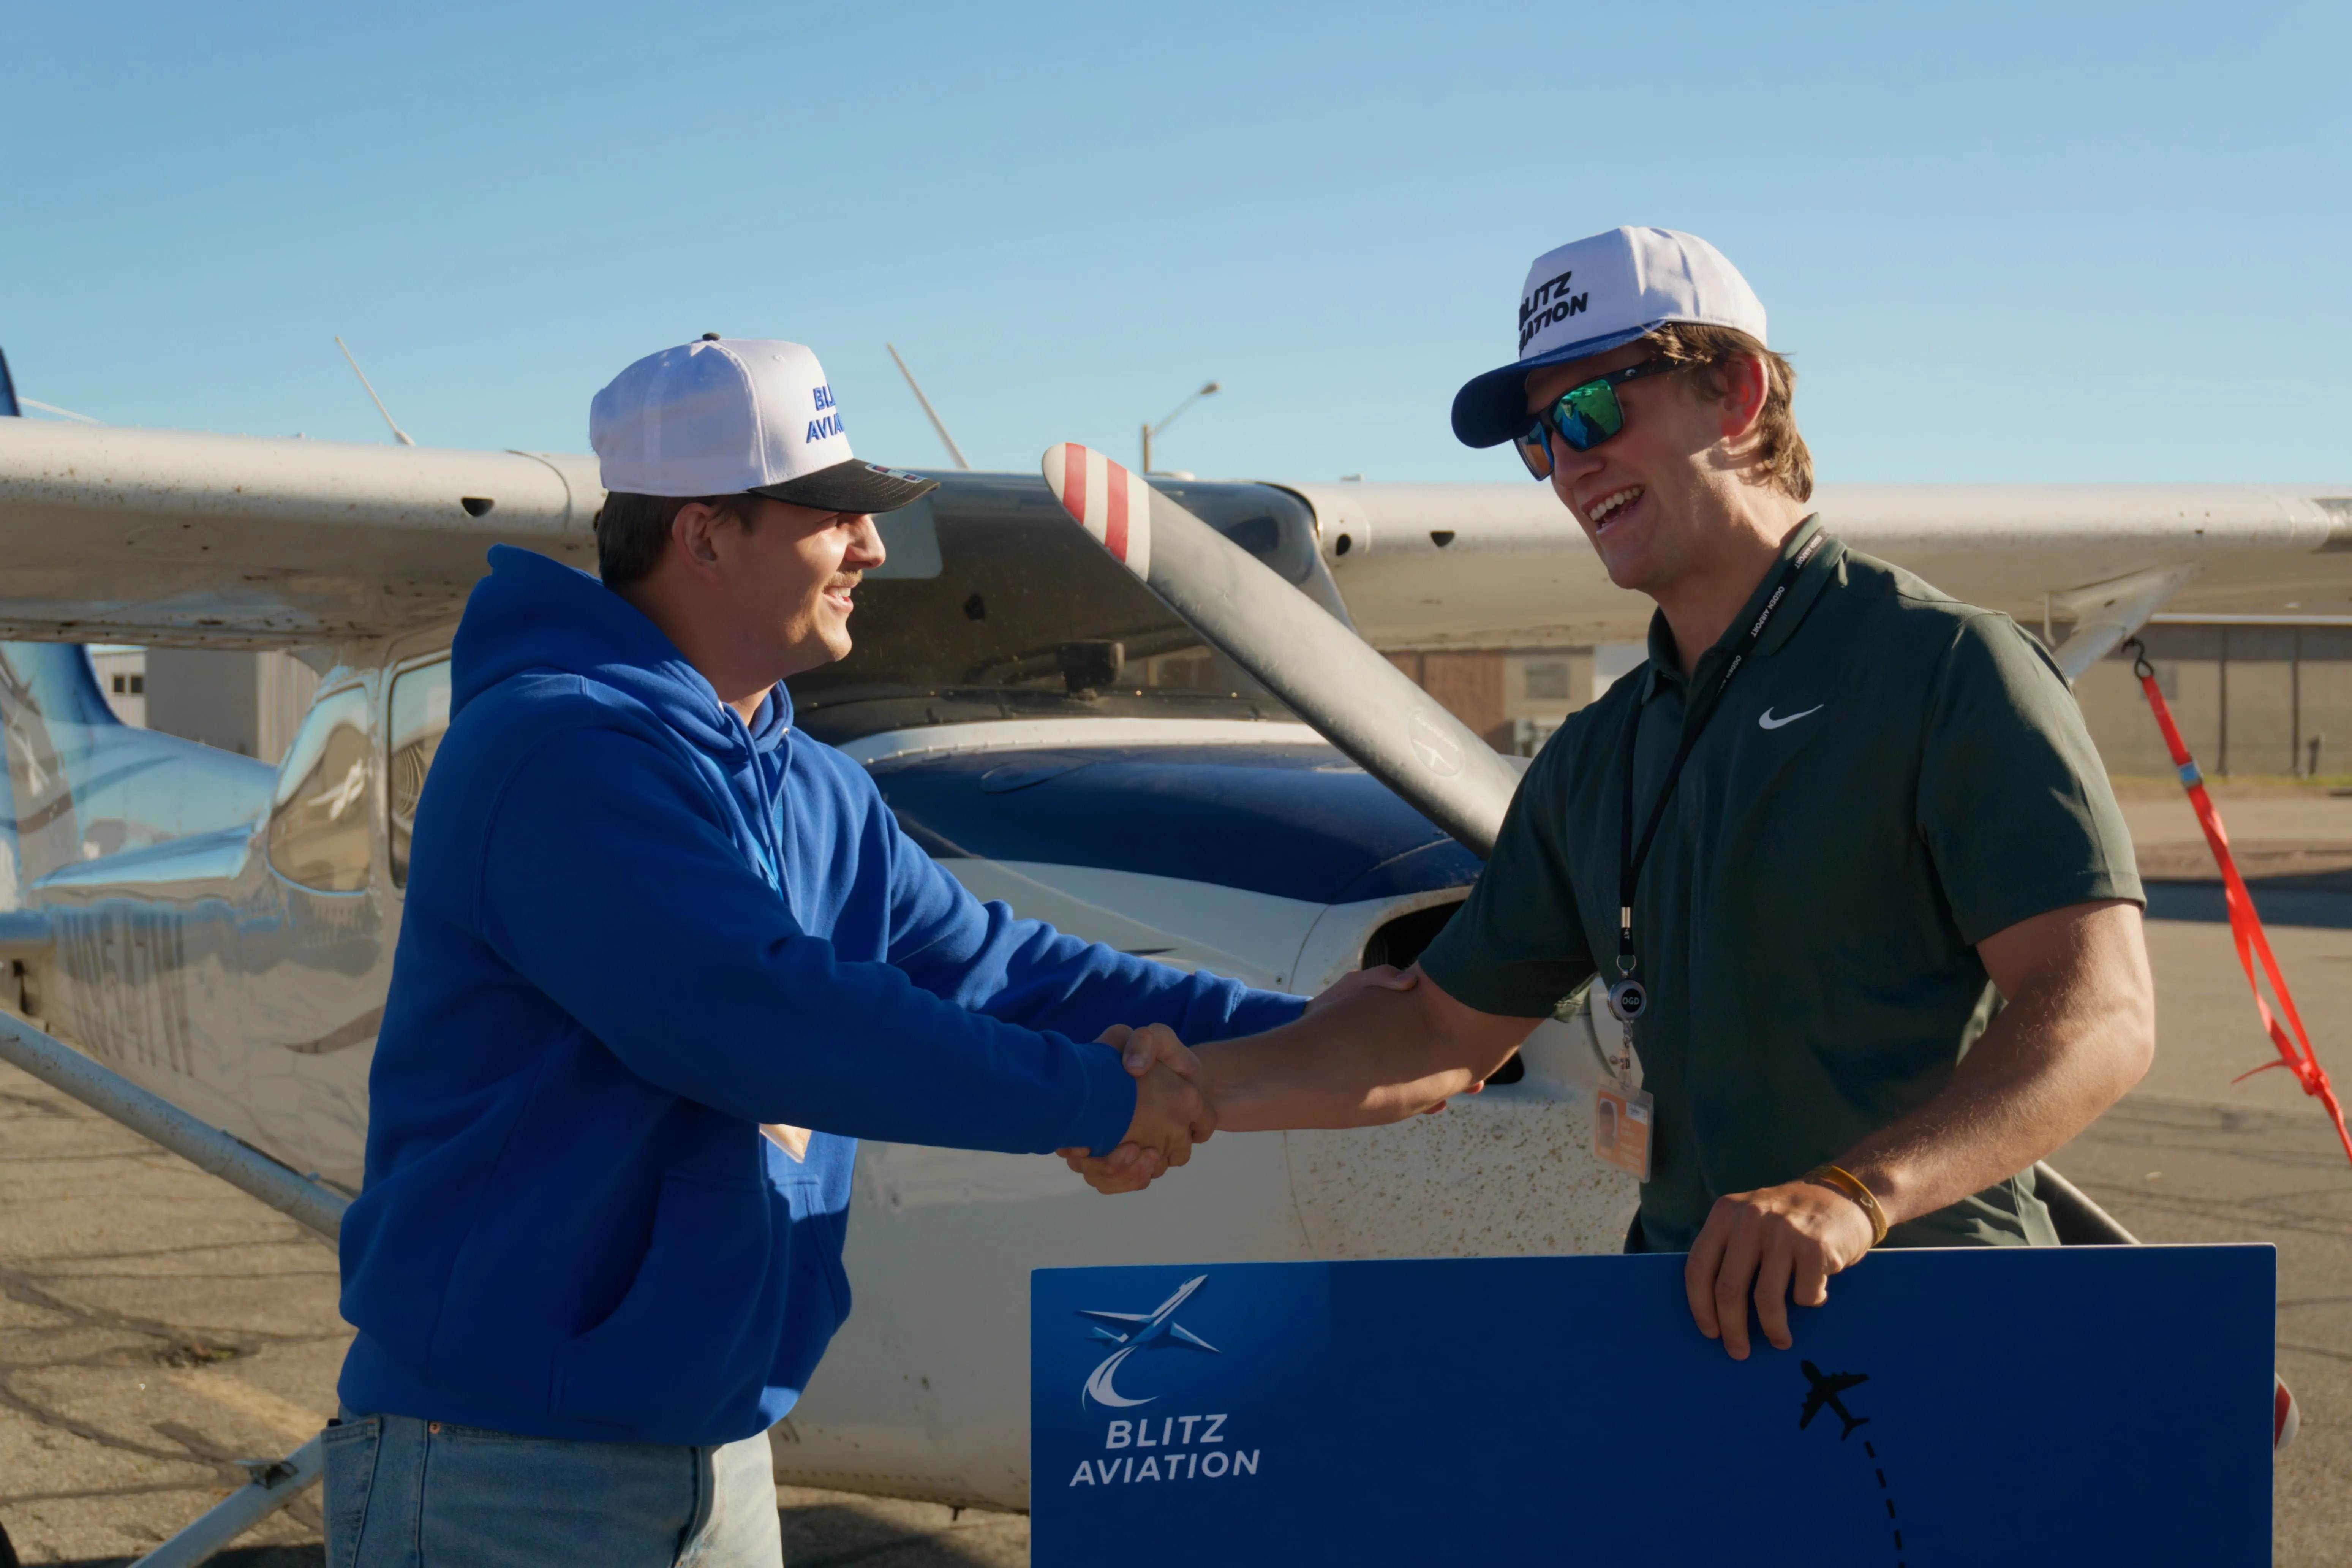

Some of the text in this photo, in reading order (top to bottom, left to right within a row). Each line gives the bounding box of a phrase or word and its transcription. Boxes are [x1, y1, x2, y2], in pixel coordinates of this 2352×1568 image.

[1750, 586, 1785, 638] OGDEN AIRPORT
[1726, 655, 1742, 678] OGDEN
[1622, 997, 1640, 1005] OGD
[1105, 1413, 1228, 1449] BLITZ
[1069, 1449, 1260, 1487] AVIATION
